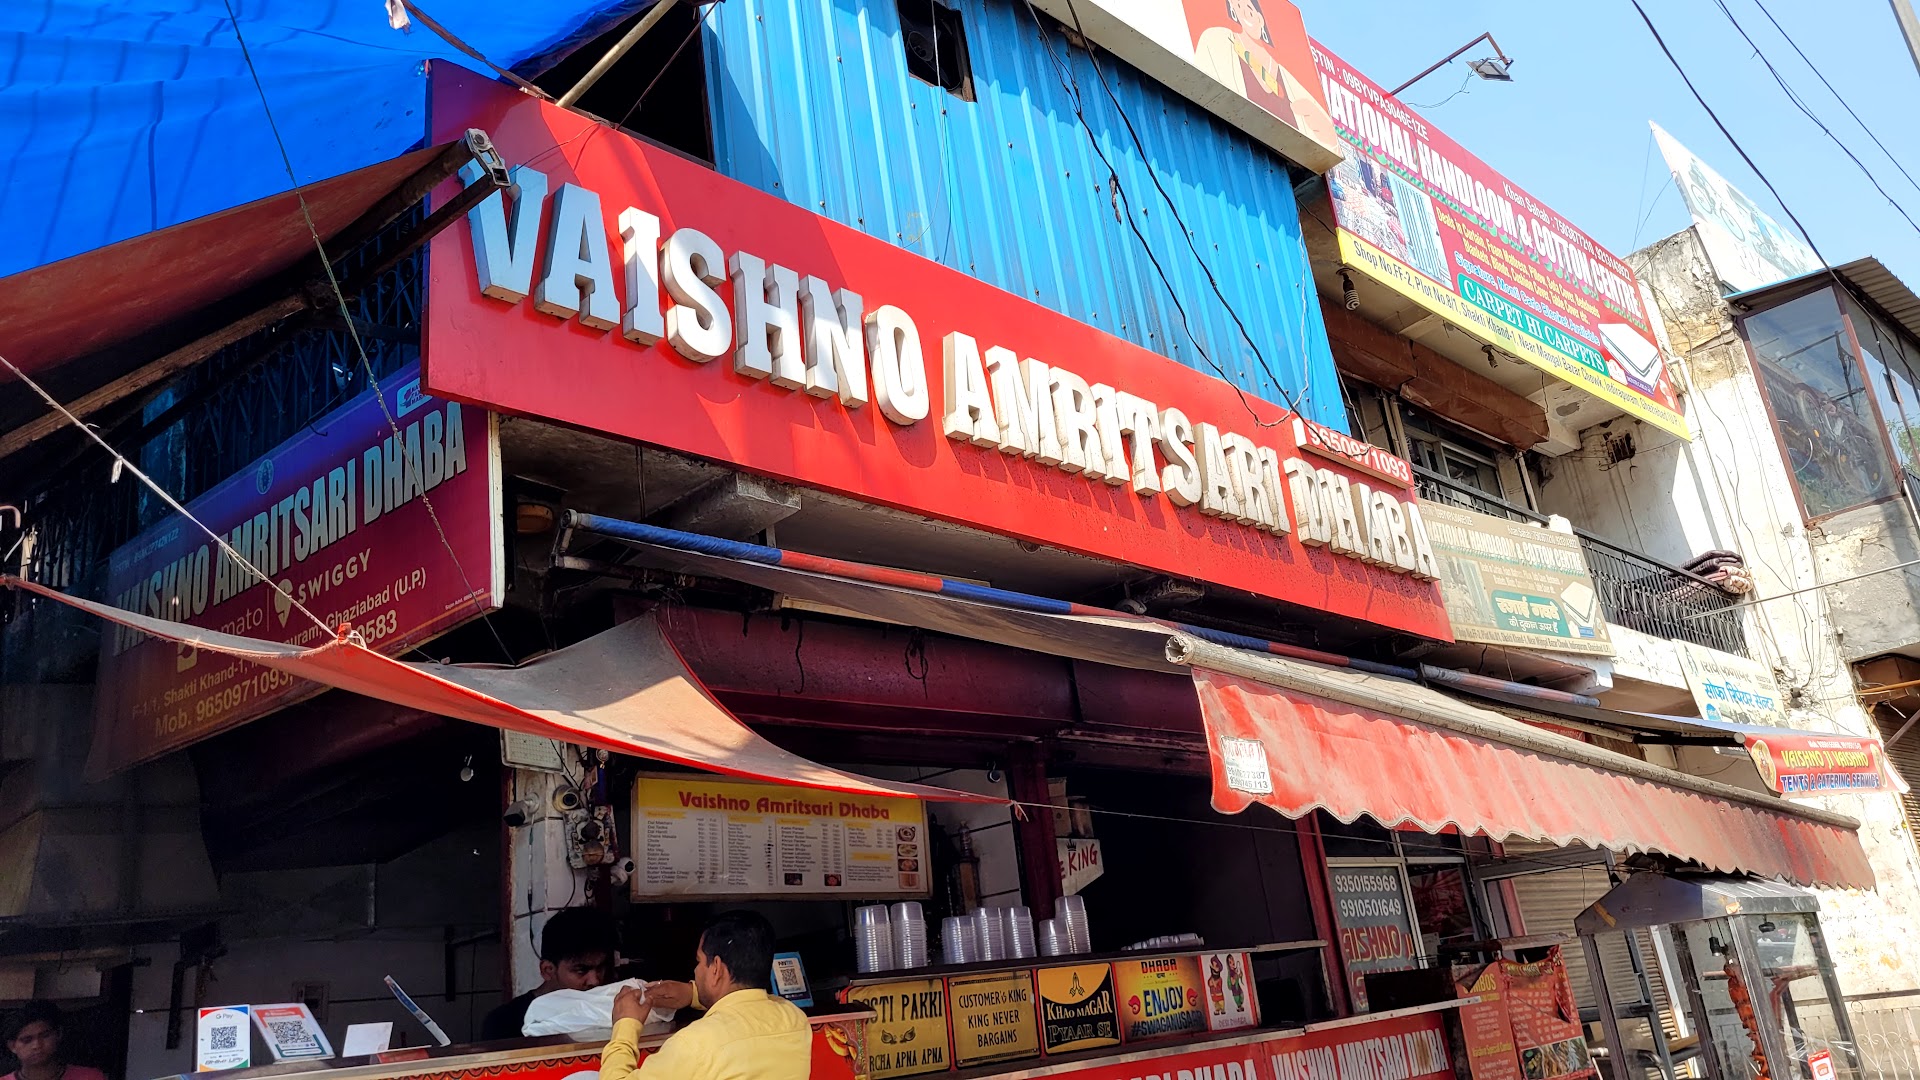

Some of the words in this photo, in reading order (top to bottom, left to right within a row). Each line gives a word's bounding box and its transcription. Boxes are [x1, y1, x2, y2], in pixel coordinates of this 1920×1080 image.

[1311, 45, 1335, 75] STIN
[1502, 181, 1526, 209] Khan
[1416, 139, 1519, 241] HANDLOOM
[1517, 213, 1533, 247] &
[1531, 218, 1593, 287] COTTON
[1589, 258, 1644, 320] CENTRE
[1353, 240, 1379, 270] Shop
[1414, 277, 1434, 298] Plot
[1461, 302, 1487, 327] Shakti
[1517, 333, 1537, 355] Near
[1463, 278, 1524, 329] CARPET
[1527, 315, 1546, 337] HI
[1543, 325, 1606, 373] CARPETS
[459, 155, 930, 426] VAISHNO
[942, 330, 1292, 537] AMRITSARI
[1282, 456, 1442, 582] DHABA
[213, 456, 356, 607] AMRITSARI
[363, 400, 467, 522] DHABA
[1424, 519, 1471, 550] NATIONAL
[1468, 527, 1517, 561] HANDLOOM
[1515, 541, 1525, 561] &
[1522, 541, 1557, 568] COTTON
[1555, 549, 1583, 571] CENTRE
[298, 548, 371, 605] SWIGGY
[163, 678, 197, 707] Shakti
[199, 658, 249, 693] Khand-1,
[325, 585, 390, 630] Ghaziabad
[394, 566, 427, 602] (U.P.)
[1517, 619, 1538, 632] दुकान
[155, 709, 193, 738] Mob.
[196, 667, 294, 723] 9650971093,
[1701, 678, 1730, 702] सोफा
[1780, 750, 1825, 769] VAISHNO
[1825, 751, 1835, 771] JI
[1834, 750, 1869, 769] VAISHNO
[1780, 774, 1809, 793] TENTS
[1809, 774, 1816, 791] &
[1816, 773, 1850, 791] CATERING
[1851, 772, 1880, 788] SERVICE
[678, 791, 751, 811] Vaishno
[756, 795, 834, 817] Amritsari
[838, 801, 890, 820] Dhaba
[1067, 843, 1098, 876] KING
[1335, 874, 1397, 893] 9350155968
[1340, 898, 1401, 918] 9910501649
[1141, 958, 1178, 974] DHABA
[1463, 973, 1497, 994] MBOS
[901, 991, 943, 1021] PAKKI
[958, 991, 1000, 1009] CUSTOMER
[1007, 988, 1027, 1003] KING
[1143, 985, 1184, 1018] ENJOY
[968, 1013, 990, 1030] KING
[993, 1009, 1020, 1025] NEVER
[1048, 1023, 1095, 1043] PYAAR
[1096, 1021, 1112, 1038] SE
[977, 1029, 1018, 1048] BARGAINS
[895, 1050, 918, 1069] APNA
[921, 1046, 943, 1065] APNA
[1271, 1045, 1339, 1080] VAISHNO
[1335, 1034, 1410, 1080] AMRITSARI
[1404, 1028, 1449, 1077] DHABA
